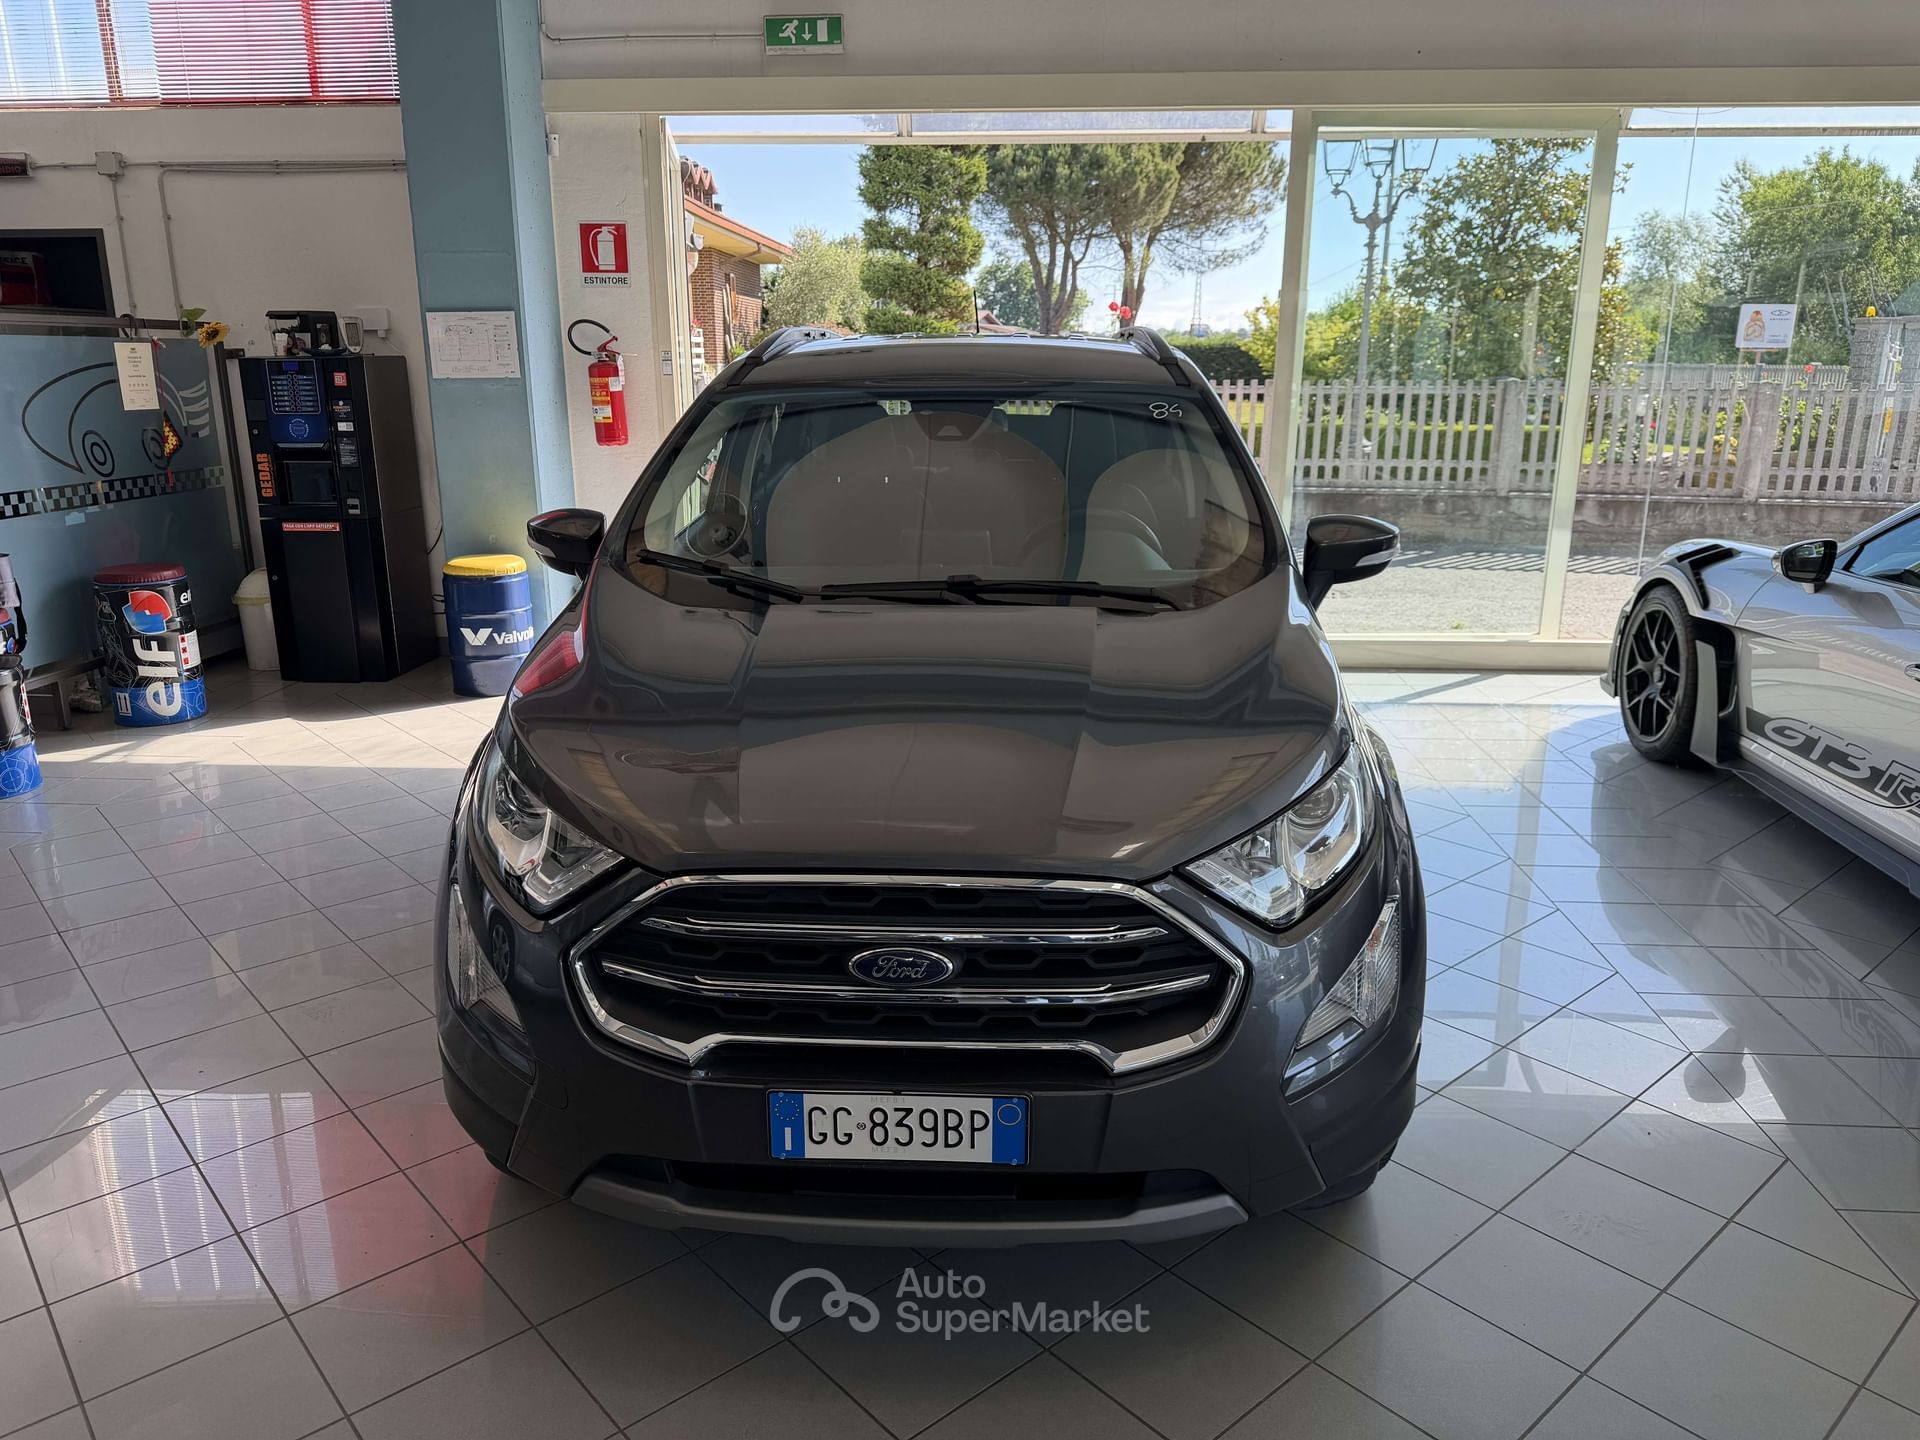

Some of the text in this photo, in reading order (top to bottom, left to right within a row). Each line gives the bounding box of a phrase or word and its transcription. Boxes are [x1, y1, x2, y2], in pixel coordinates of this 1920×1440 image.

[584, 276, 628, 285] ESTINTORE
[256, 453, 273, 497] GEDAR
[132, 638, 182, 716] elf
[1764, 717, 1872, 779] GT3
[872, 955, 930, 978] Ford
